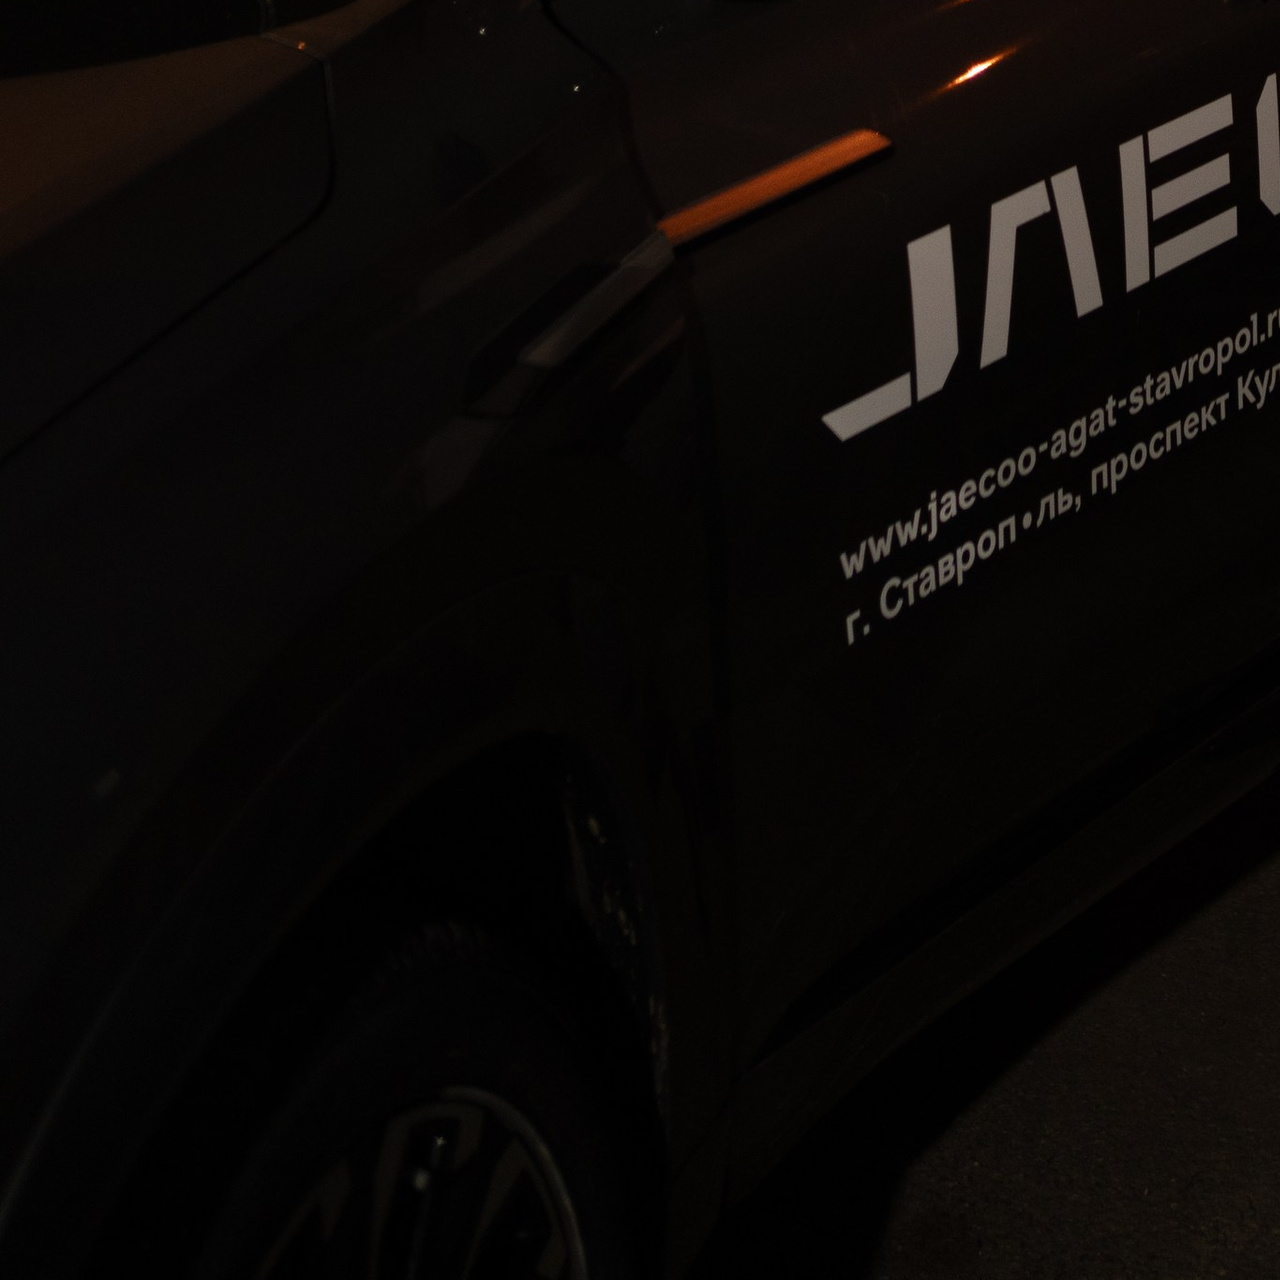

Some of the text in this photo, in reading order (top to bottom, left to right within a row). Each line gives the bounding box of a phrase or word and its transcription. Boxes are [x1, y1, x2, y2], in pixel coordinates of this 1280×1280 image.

[846, 608, 871, 646] г.
[879, 487, 1082, 620] Ставропль,
[1091, 392, 1230, 496] проспект
